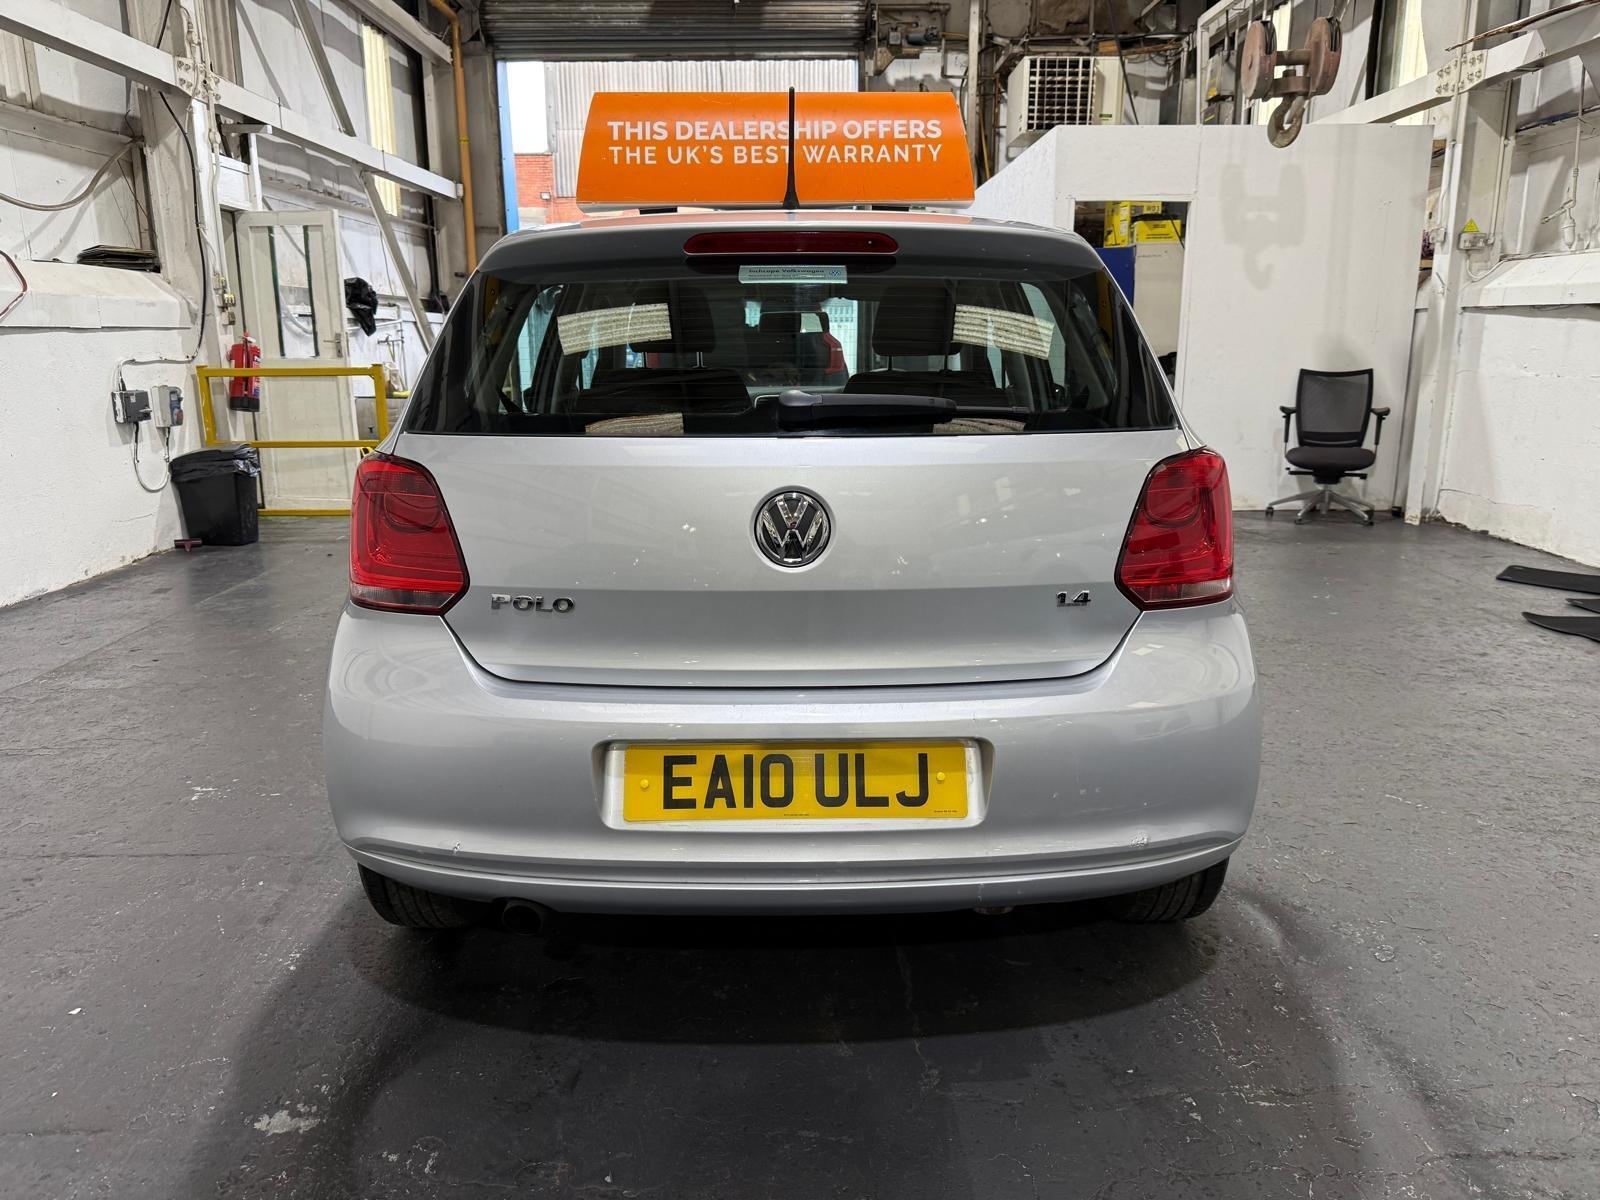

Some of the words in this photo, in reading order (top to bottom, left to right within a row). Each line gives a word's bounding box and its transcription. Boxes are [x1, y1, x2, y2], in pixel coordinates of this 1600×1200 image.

[607, 121, 669, 140] THIS
[675, 120, 837, 140] DEALERSHIP
[842, 119, 942, 139] OFFERS
[608, 146, 657, 164] THE
[667, 145, 724, 164] UK'S
[734, 145, 790, 164] BEST
[802, 144, 943, 163] WARRANTY
[490, 593, 575, 613] POLO
[663, 753, 794, 809] EA10
[814, 753, 930, 808] ULJ
